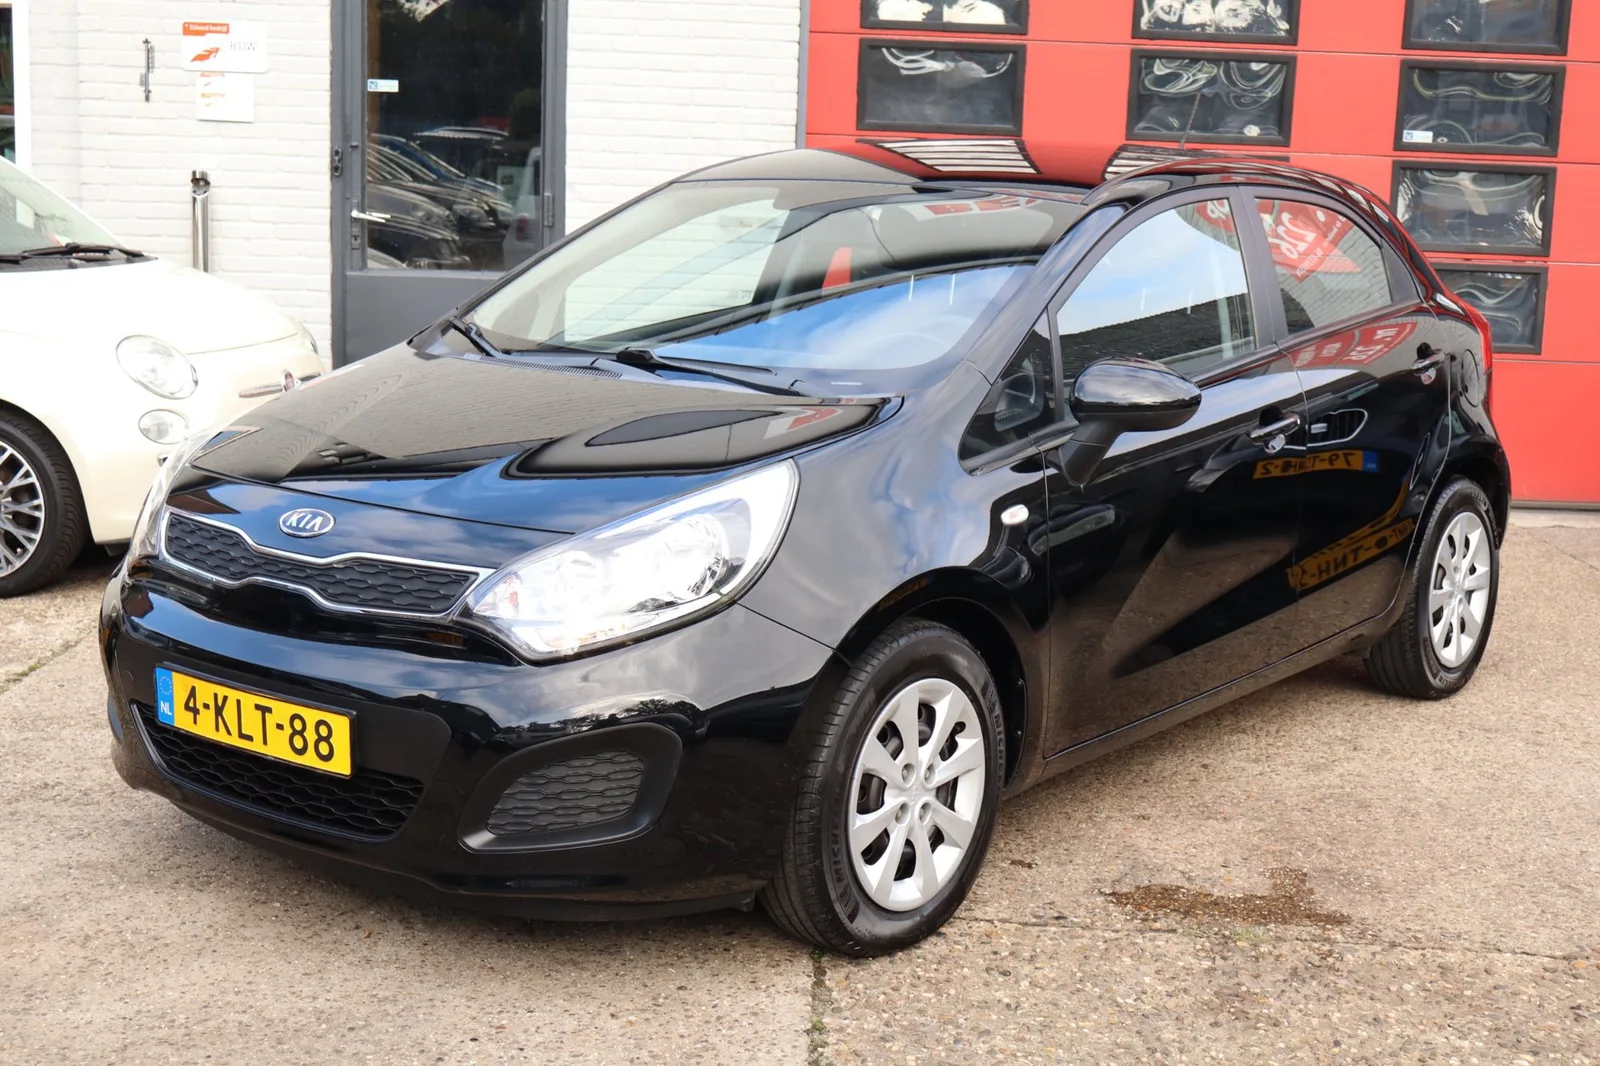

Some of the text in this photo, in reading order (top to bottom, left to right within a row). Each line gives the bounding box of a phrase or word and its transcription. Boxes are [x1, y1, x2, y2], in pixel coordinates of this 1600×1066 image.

[285, 512, 324, 532] KIA
[160, 700, 173, 716] NL
[184, 685, 335, 762] 4-KLT-88
